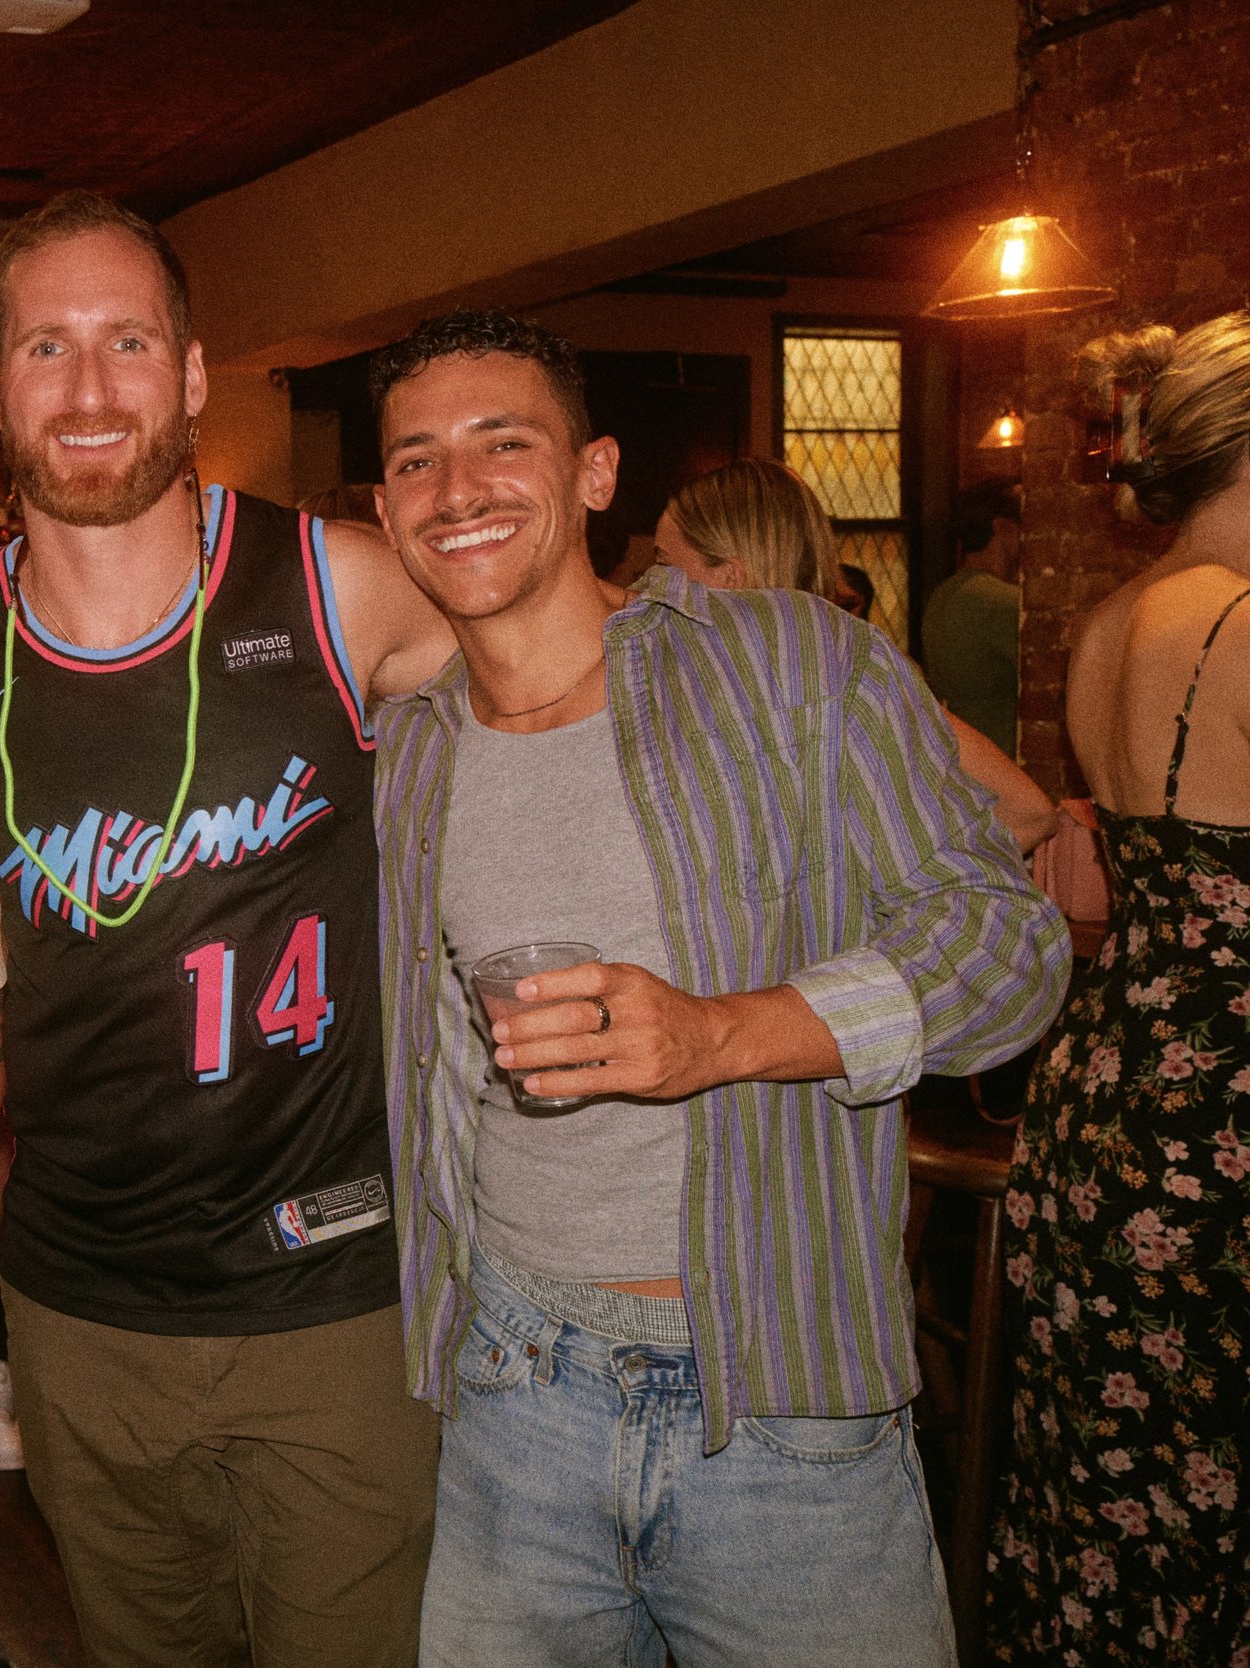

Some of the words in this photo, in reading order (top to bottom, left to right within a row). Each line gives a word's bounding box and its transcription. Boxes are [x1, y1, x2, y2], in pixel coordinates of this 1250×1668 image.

[224, 634, 290, 657] Ultimate
[228, 649, 293, 669] SOFTWARE
[183, 914, 335, 1084] 14
[305, 1204, 318, 1216] 48
